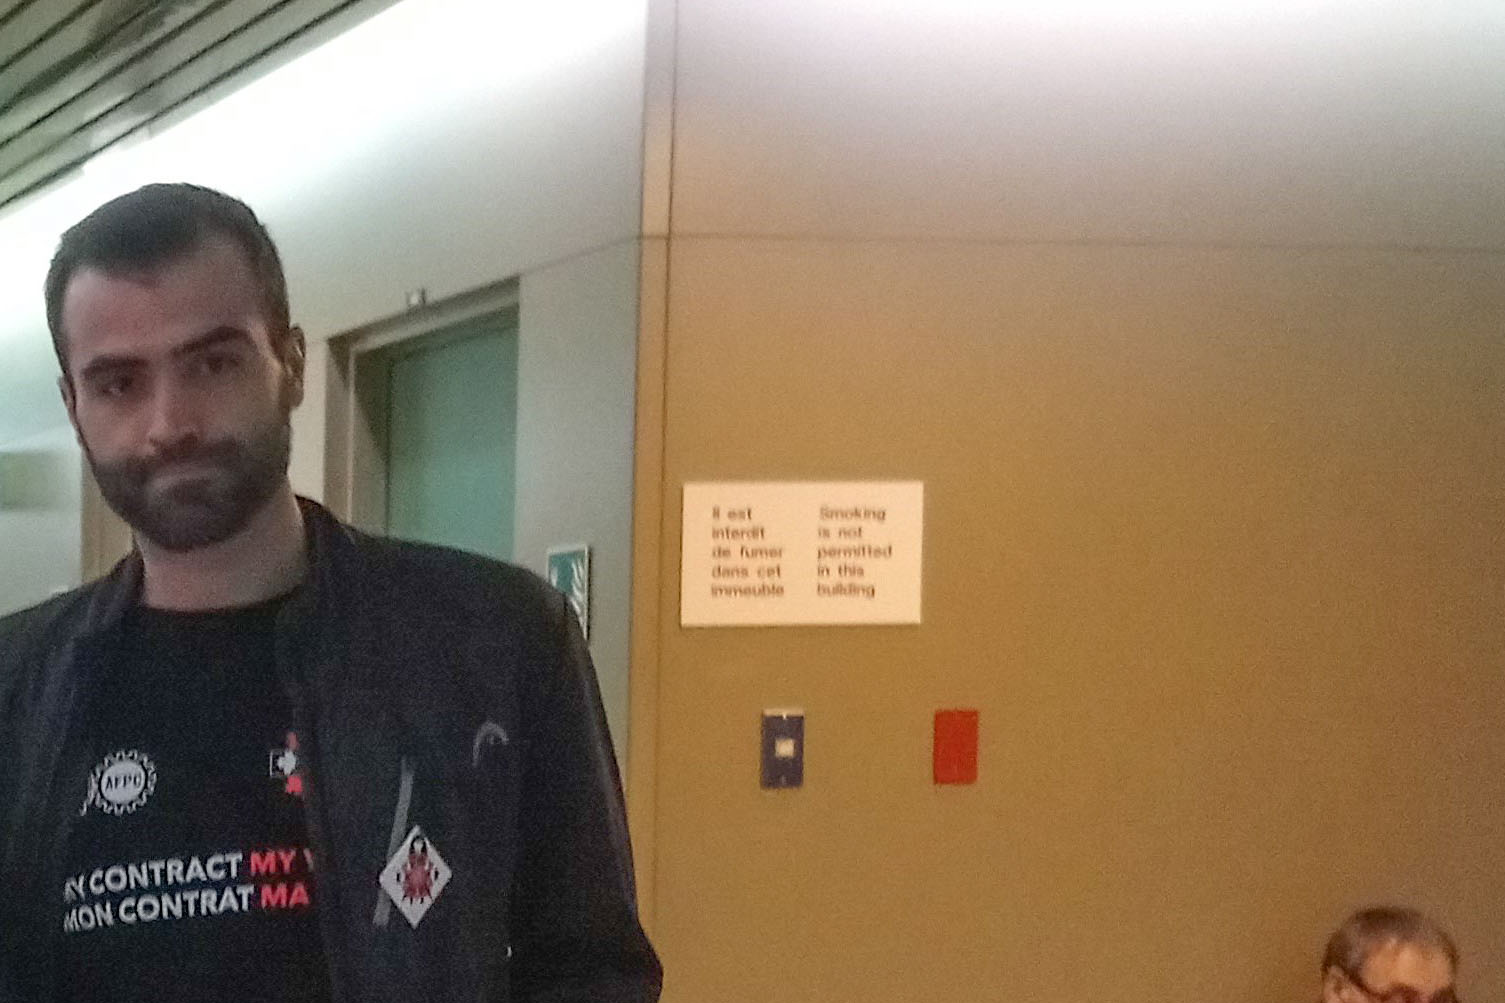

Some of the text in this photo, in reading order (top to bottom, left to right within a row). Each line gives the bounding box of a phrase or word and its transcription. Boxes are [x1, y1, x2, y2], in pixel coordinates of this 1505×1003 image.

[727, 506, 753, 521] est
[819, 506, 887, 524] Smoking
[711, 526, 766, 540] interdit
[818, 526, 863, 539] is not
[711, 546, 783, 559] de fumer
[817, 545, 893, 561] permitted
[711, 564, 781, 578] dans cet
[817, 564, 865, 577] in this
[711, 583, 785, 598] immeuble
[817, 582, 876, 599] building
[88, 849, 244, 896] CONTRACT
[249, 847, 297, 876] MY
[62, 882, 310, 933] MON CONTRAT MA
